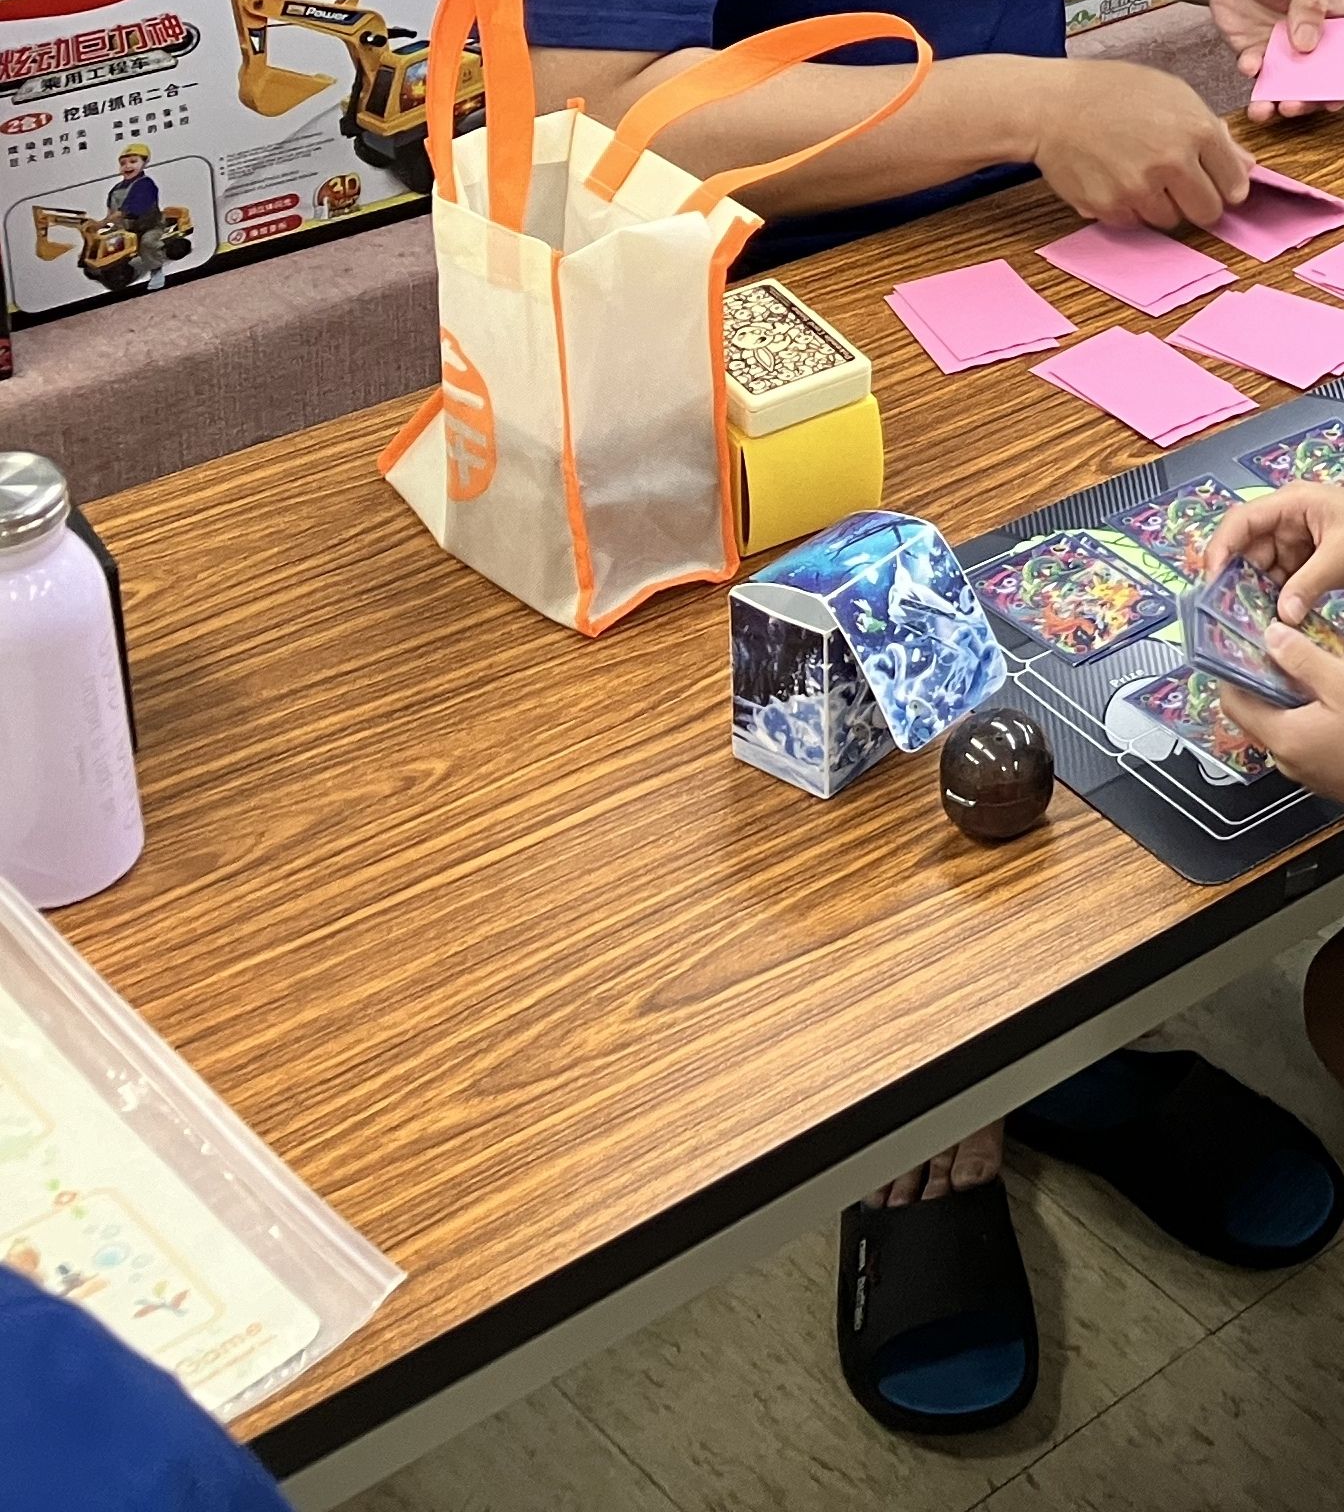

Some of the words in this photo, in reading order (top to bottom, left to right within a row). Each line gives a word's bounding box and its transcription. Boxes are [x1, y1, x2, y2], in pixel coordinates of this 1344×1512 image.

[305, 3, 352, 22] Power
[40, 56, 149, 92] 乘用工程车
[63, 82, 199, 123] 挖掘/抓吊二合一
[327, 176, 362, 197] 3D
[1110, 668, 1145, 689] Prize
